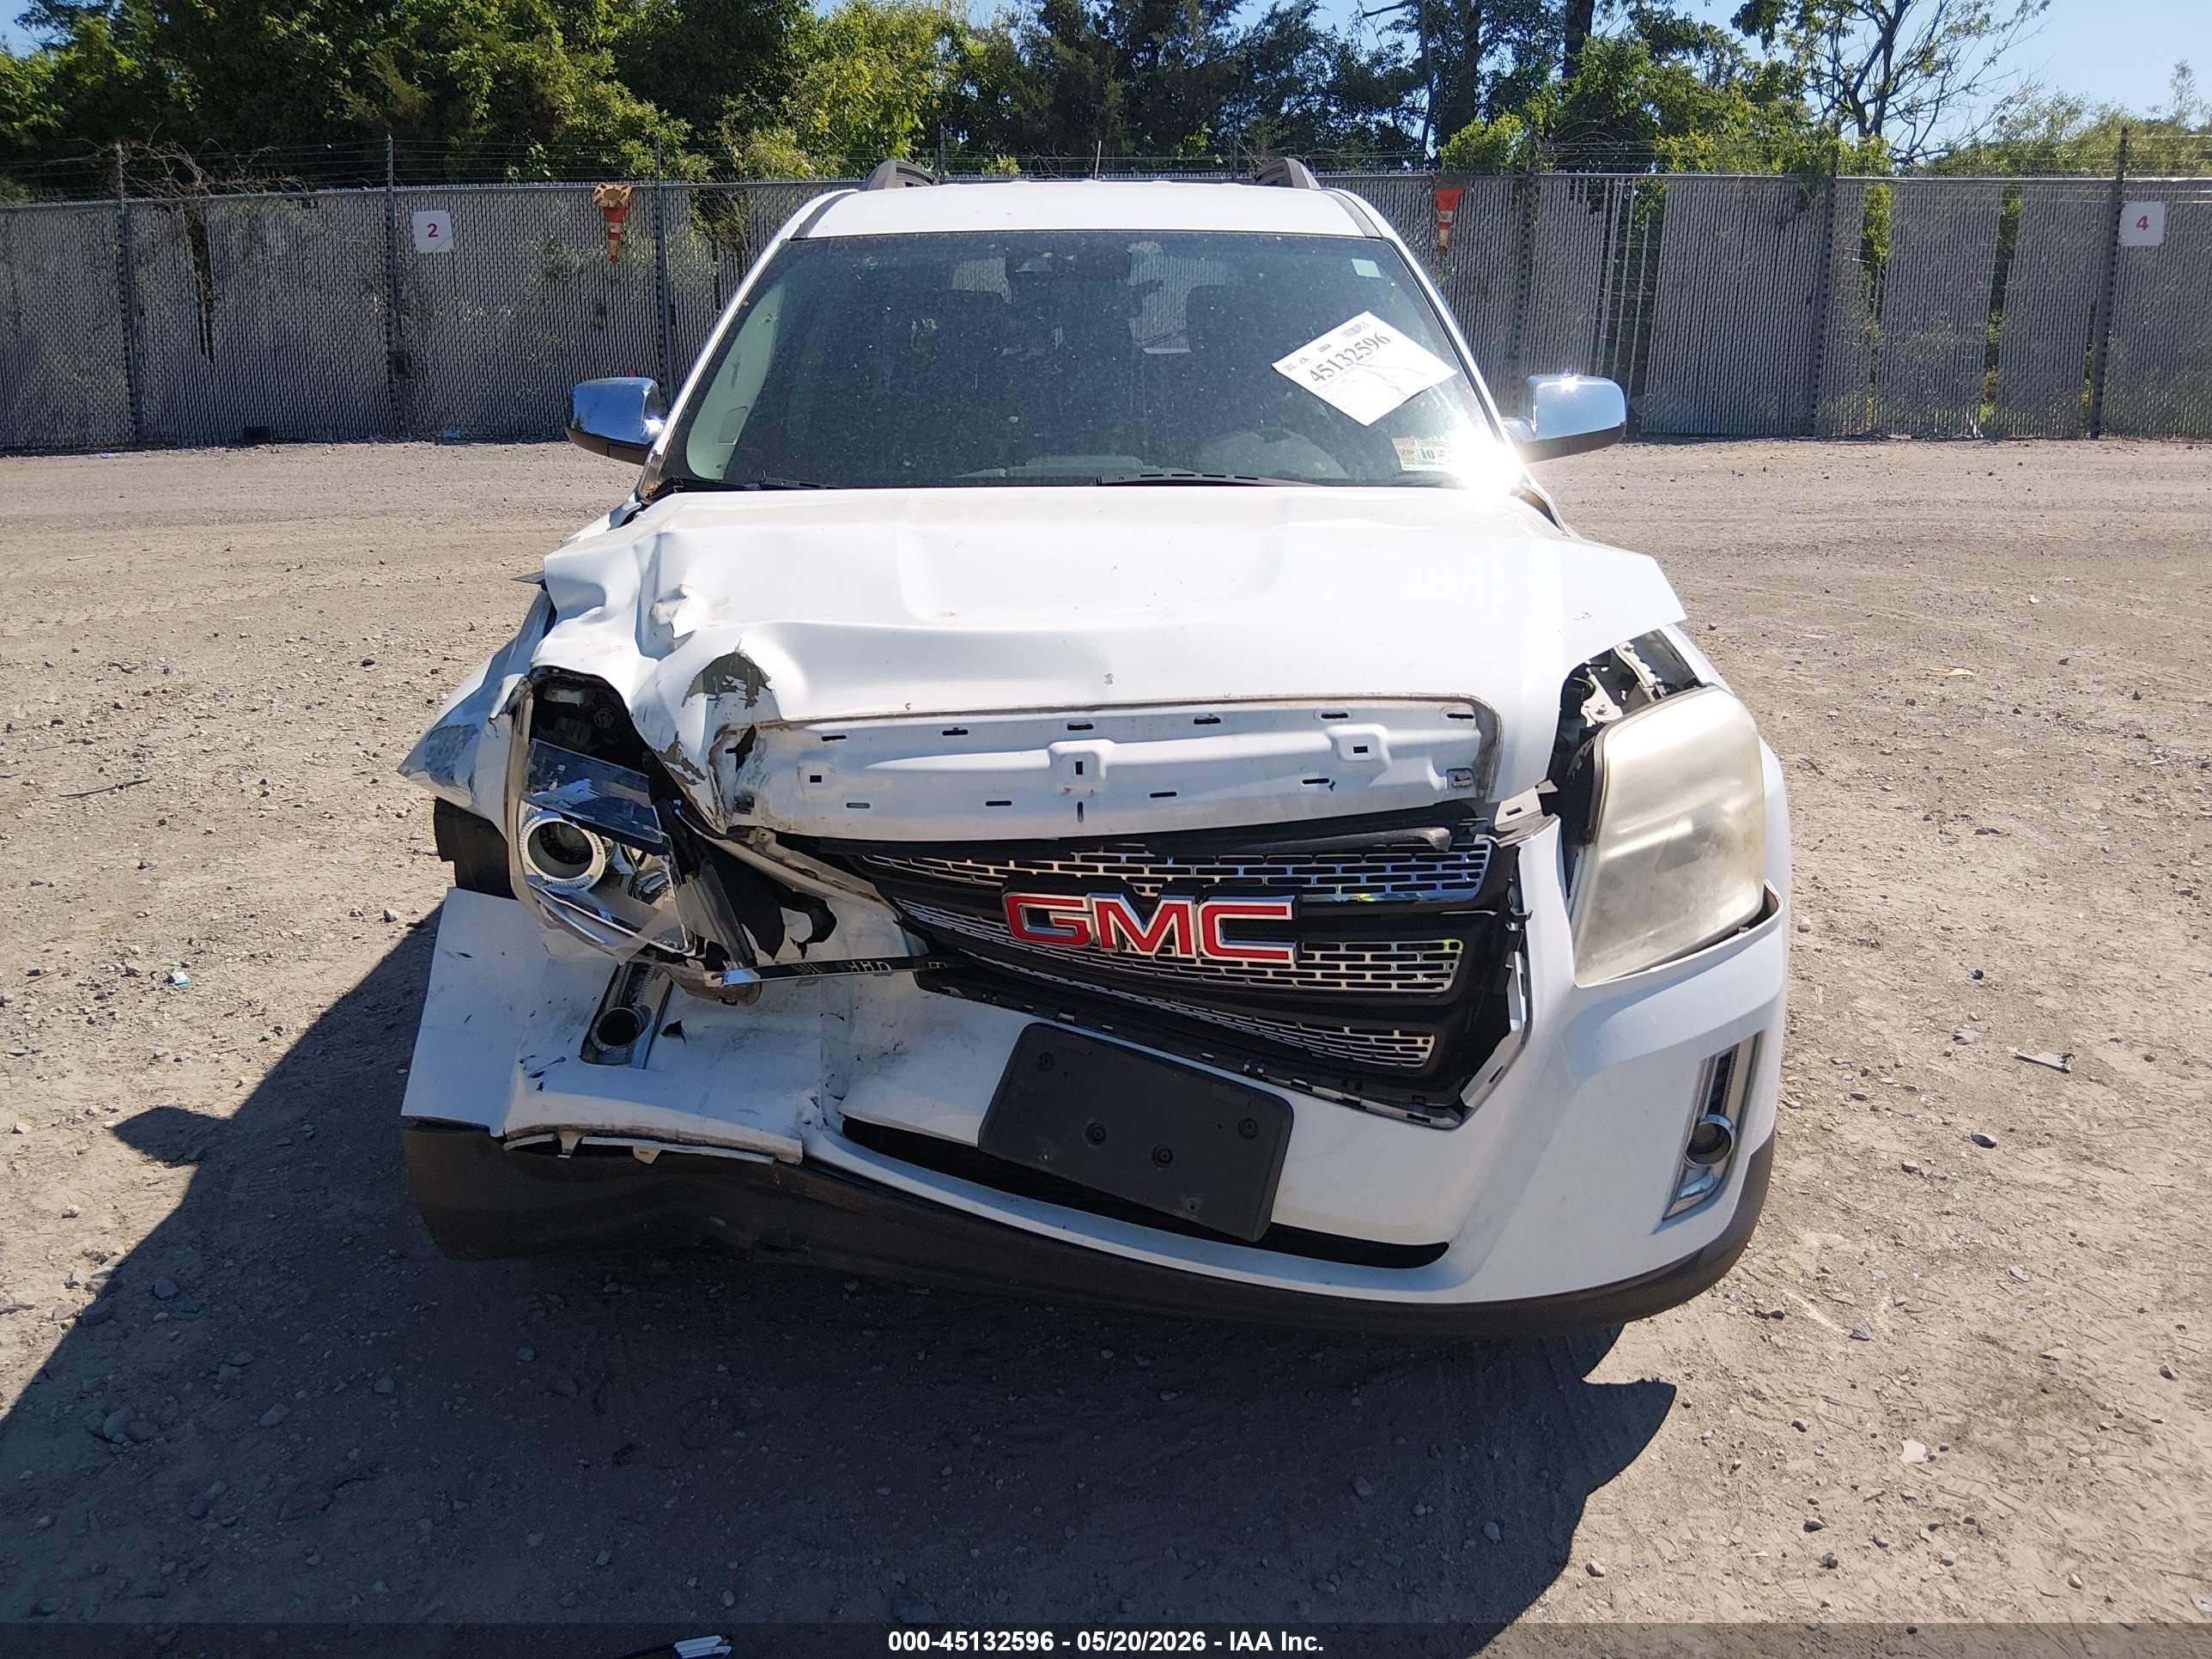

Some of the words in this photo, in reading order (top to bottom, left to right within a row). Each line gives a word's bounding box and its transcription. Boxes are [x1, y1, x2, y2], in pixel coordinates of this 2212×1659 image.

[427, 222, 439, 238] 2
[2136, 216, 2149, 231] 4
[1310, 331, 1391, 382] 45132596
[1002, 892, 1297, 963] GMC
